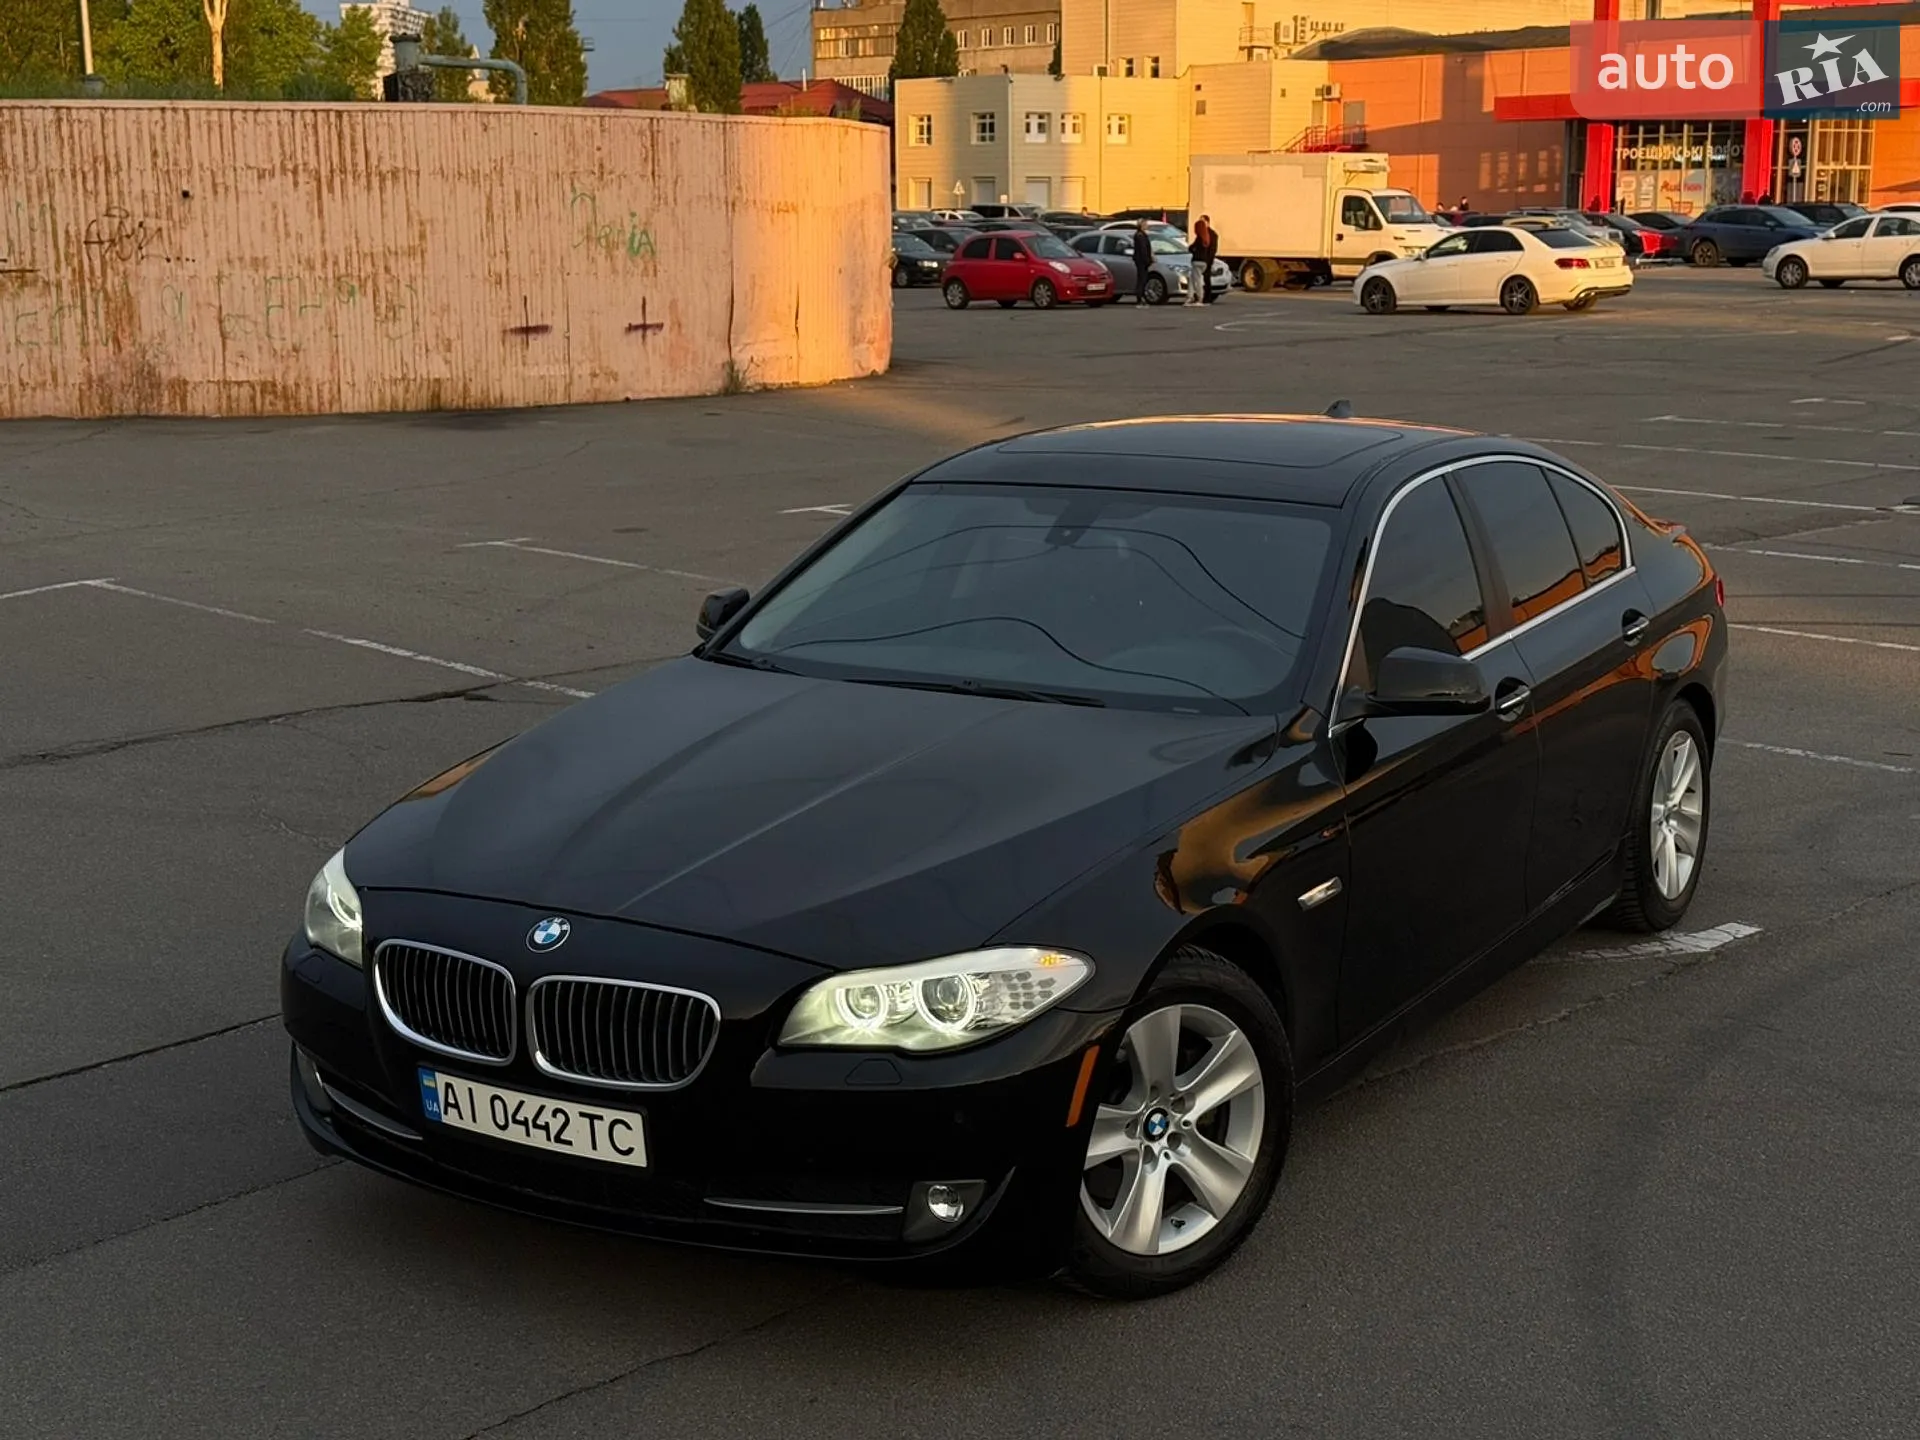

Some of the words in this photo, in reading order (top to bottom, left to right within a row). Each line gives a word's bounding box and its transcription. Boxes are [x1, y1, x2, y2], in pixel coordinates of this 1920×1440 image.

[425, 1100, 441, 1114] UA
[443, 1081, 478, 1124] AI
[489, 1093, 574, 1147] 0442
[578, 1110, 636, 1157] TC
